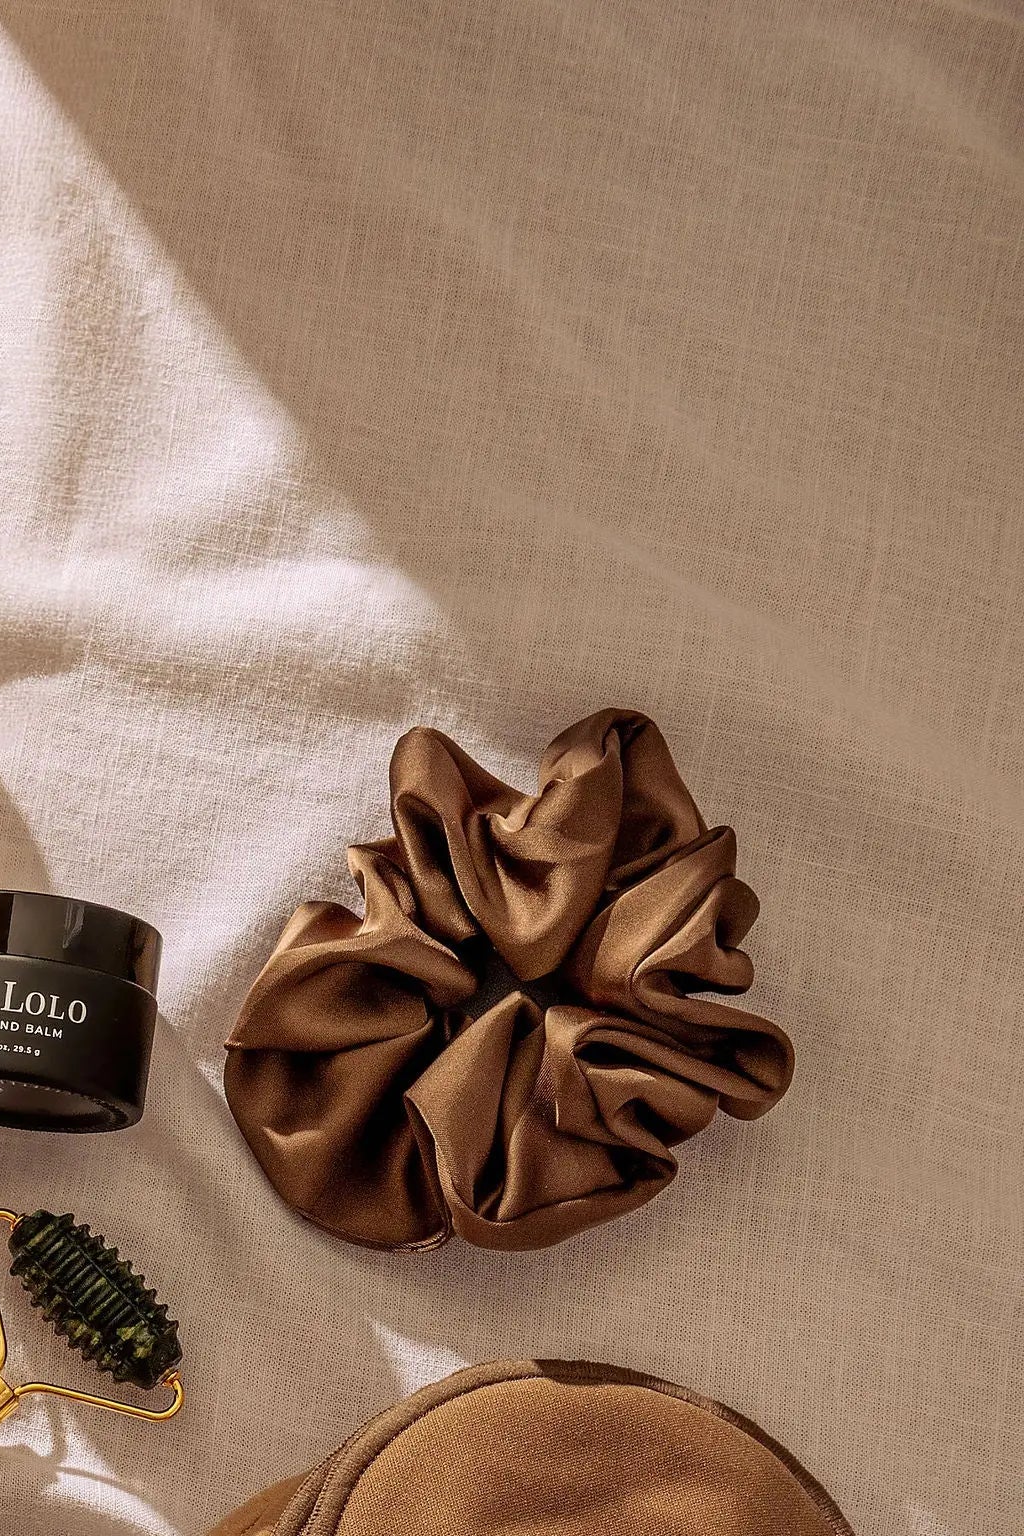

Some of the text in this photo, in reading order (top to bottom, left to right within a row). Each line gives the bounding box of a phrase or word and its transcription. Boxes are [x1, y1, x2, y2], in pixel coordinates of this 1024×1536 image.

[25, 1023, 63, 1039] BALM
[12, 1045, 32, 1054] 29.5
[34, 1049, 41, 1057] g
